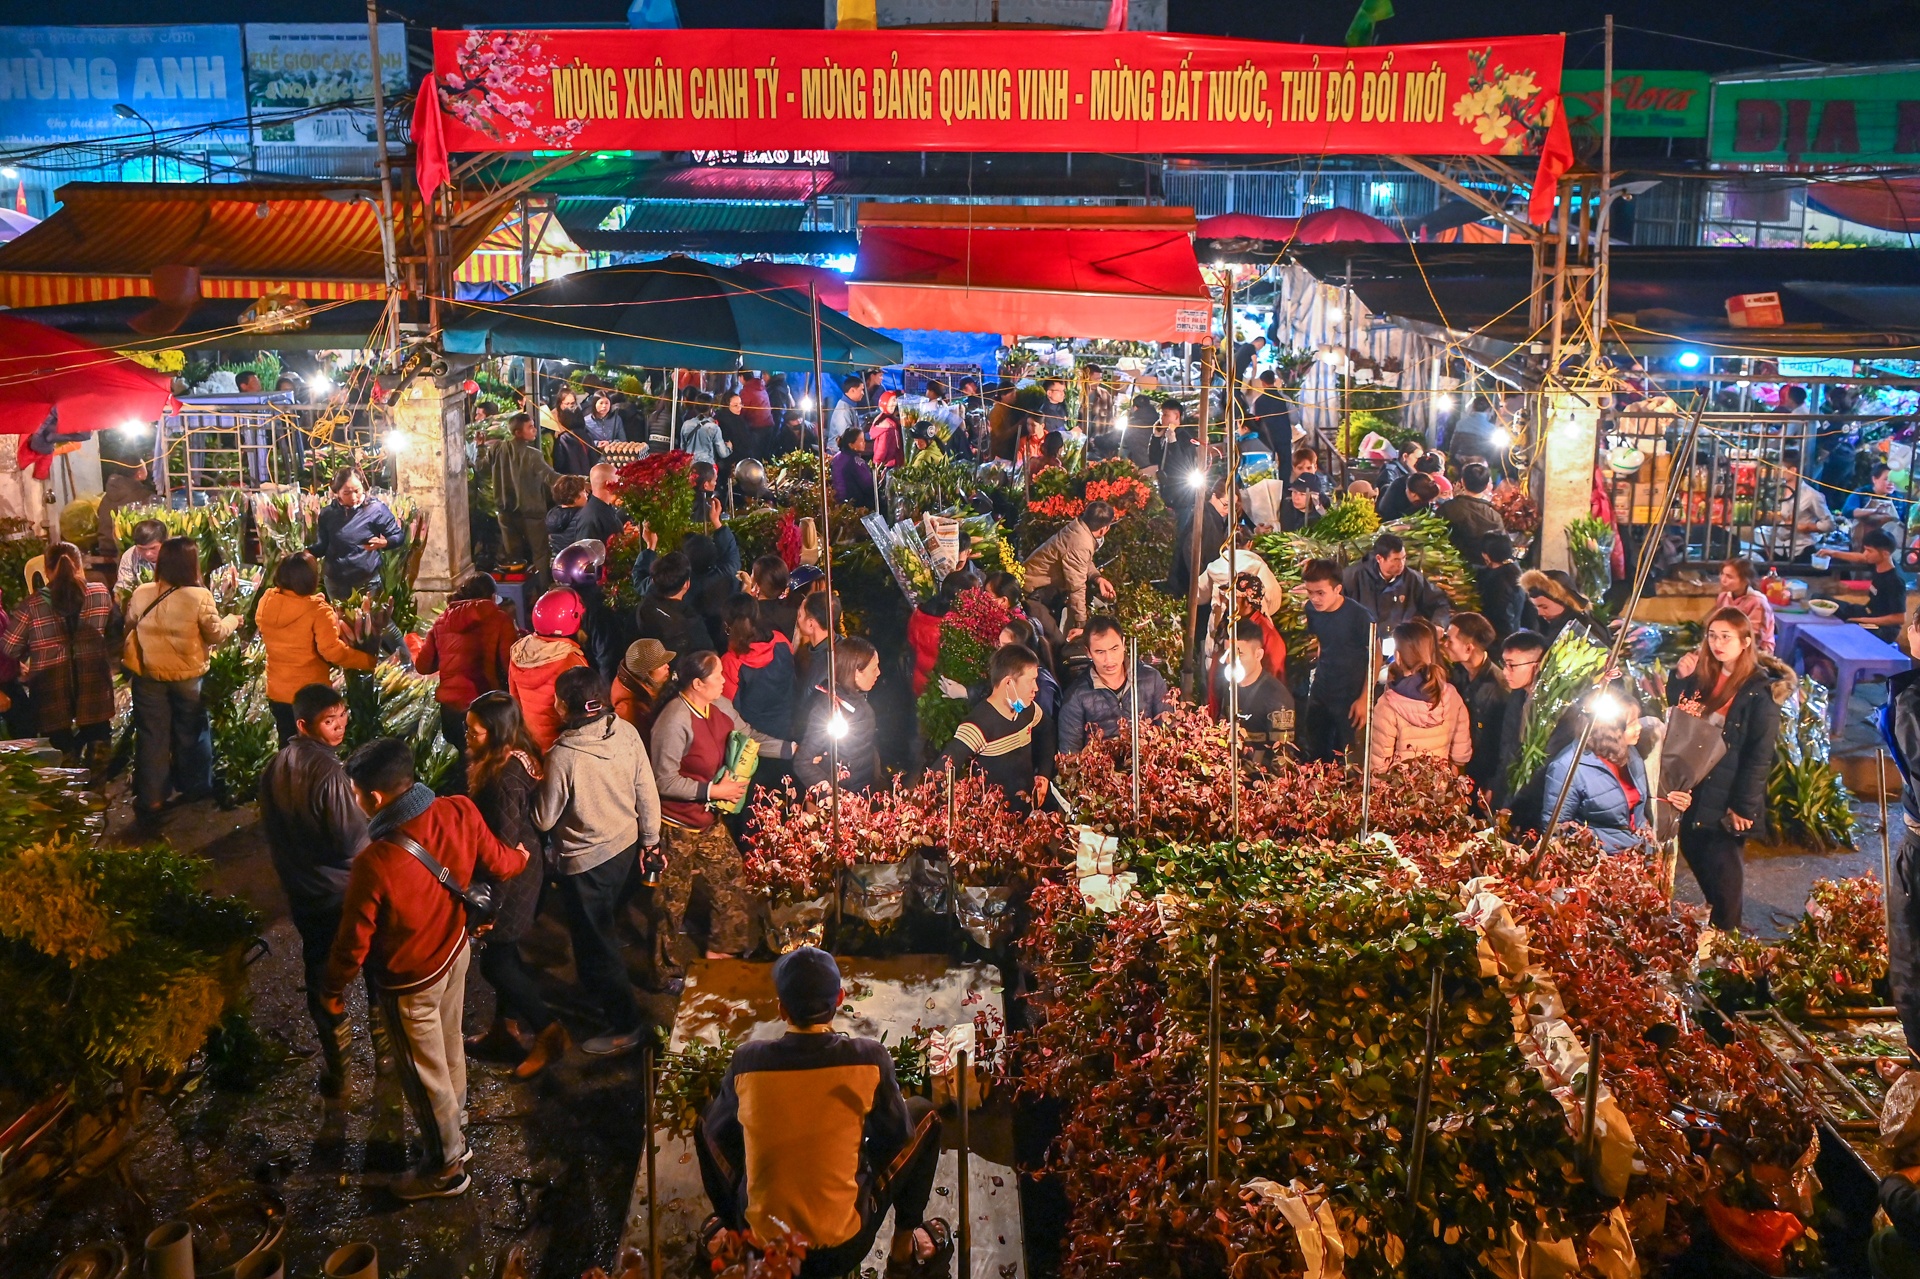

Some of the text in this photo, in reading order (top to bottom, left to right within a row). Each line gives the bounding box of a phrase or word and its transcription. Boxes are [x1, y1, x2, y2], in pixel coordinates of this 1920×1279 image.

[1, 49, 227, 100] HÙNG ANH
[357, 52, 402, 70] CNH
[553, 57, 617, 119] MỪNG
[624, 57, 683, 119] XUÂN
[691, 67, 748, 119] CANH
[754, 57, 779, 119] TÝ
[802, 57, 866, 119] MỪNG
[873, 50, 932, 120] ĐẢNG
[940, 68, 1011, 126] QUANG
[1018, 69, 1068, 120] VINH
[1090, 59, 1154, 121] MỪNG
[1161, 51, 1203, 121] ĐẤT
[1208, 60, 1272, 128] NƯỚC,
[1282, 54, 1320, 122] THỦ
[1326, 61, 1355, 122] ĐÔ
[1361, 51, 1398, 123] ĐỔI
[1404, 61, 1447, 122] MỚI
